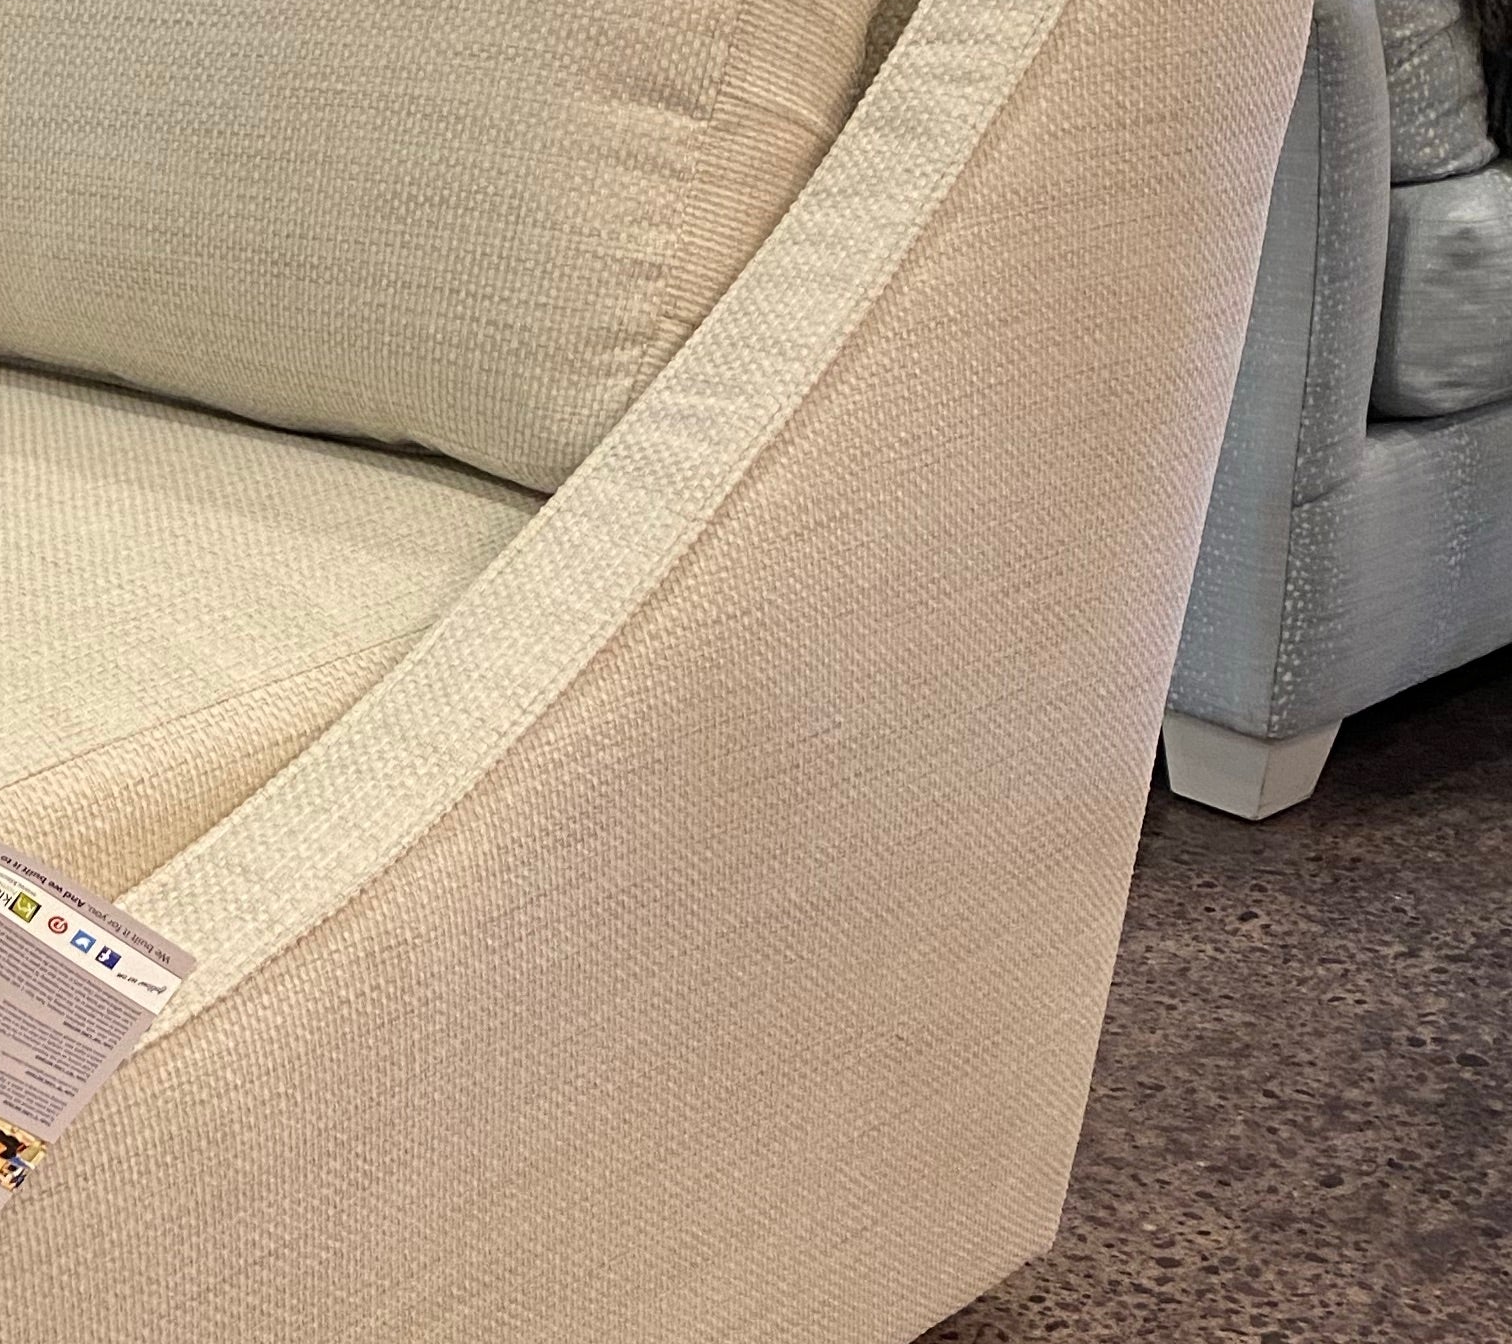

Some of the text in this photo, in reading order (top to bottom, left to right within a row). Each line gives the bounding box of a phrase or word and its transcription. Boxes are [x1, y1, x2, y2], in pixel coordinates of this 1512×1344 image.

[0, 853, 12, 864] to
[11, 860, 21, 870] it
[21, 866, 47, 884] built
[47, 880, 63, 892] we
[62, 890, 85, 907] And
[105, 918, 122, 932] for
[121, 927, 131, 938] it
[130, 933, 154, 953] built
[153, 948, 172, 963] We
